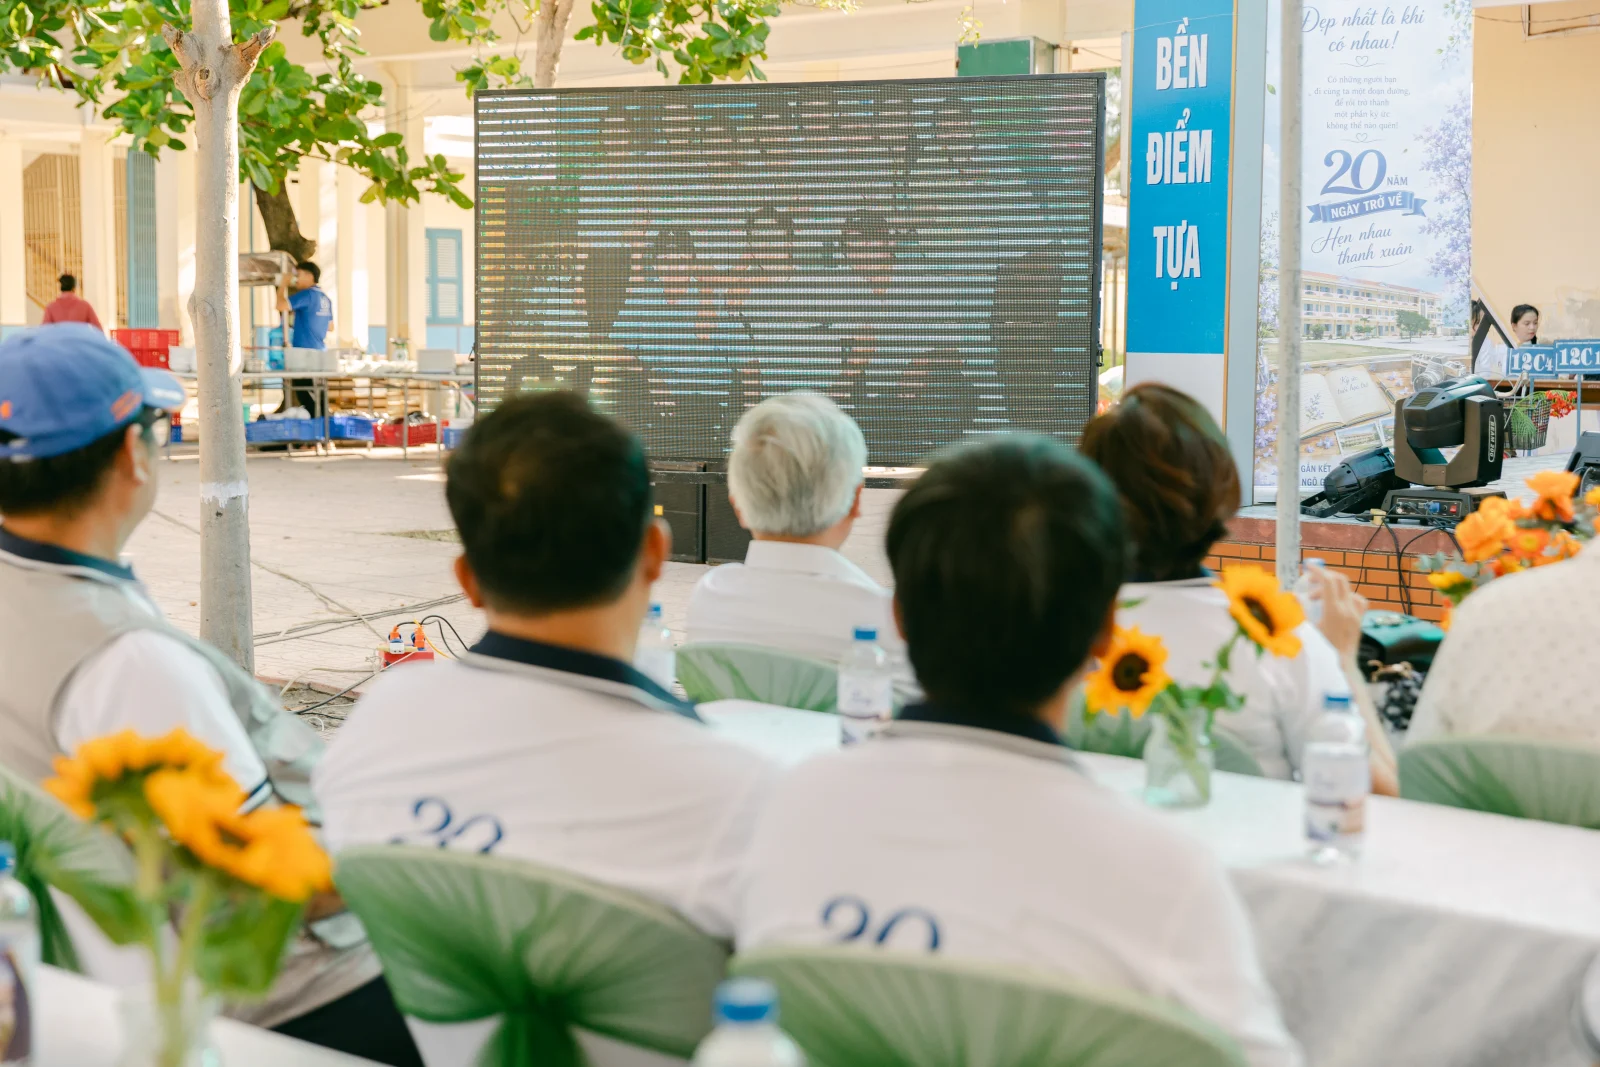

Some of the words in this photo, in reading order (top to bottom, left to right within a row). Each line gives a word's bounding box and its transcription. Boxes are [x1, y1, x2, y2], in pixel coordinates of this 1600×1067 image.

[1300, 6, 1337, 36] Đẹp
[1341, 7, 1377, 27] nhất
[1381, 9, 1396, 25] là
[1400, 5, 1426, 25] khi
[1328, 36, 1346, 52] có
[1350, 30, 1399, 51] nhau!
[1156, 17, 1208, 90] BỀN
[1327, 75, 1338, 83] Có
[1339, 75, 1362, 85] những
[1363, 75, 1382, 85] người
[1384, 75, 1397, 85] bạn
[1313, 87, 1321, 95] đi
[1323, 87, 1341, 97] cùng
[1352, 87, 1366, 96] một
[1146, 107, 1213, 185] ĐIỂM
[1320, 149, 1387, 196] 20
[1386, 174, 1408, 186] NĂM
[1330, 202, 1361, 219] NGÀY
[1364, 197, 1386, 212] TRỞ
[1388, 192, 1403, 206] VỀ
[1310, 226, 1354, 254] Hẹn
[1358, 222, 1392, 241] nhau
[1153, 219, 1201, 290] TỰA
[1337, 243, 1375, 265] thanh
[1379, 242, 1415, 260] xuân
[1511, 353, 1554, 372] 12C4
[1559, 347, 1600, 366] 12C1
[1301, 462, 1316, 473] GẮN
[1318, 462, 1332, 473] KẾT
[1301, 476, 1318, 486] NGÔ
